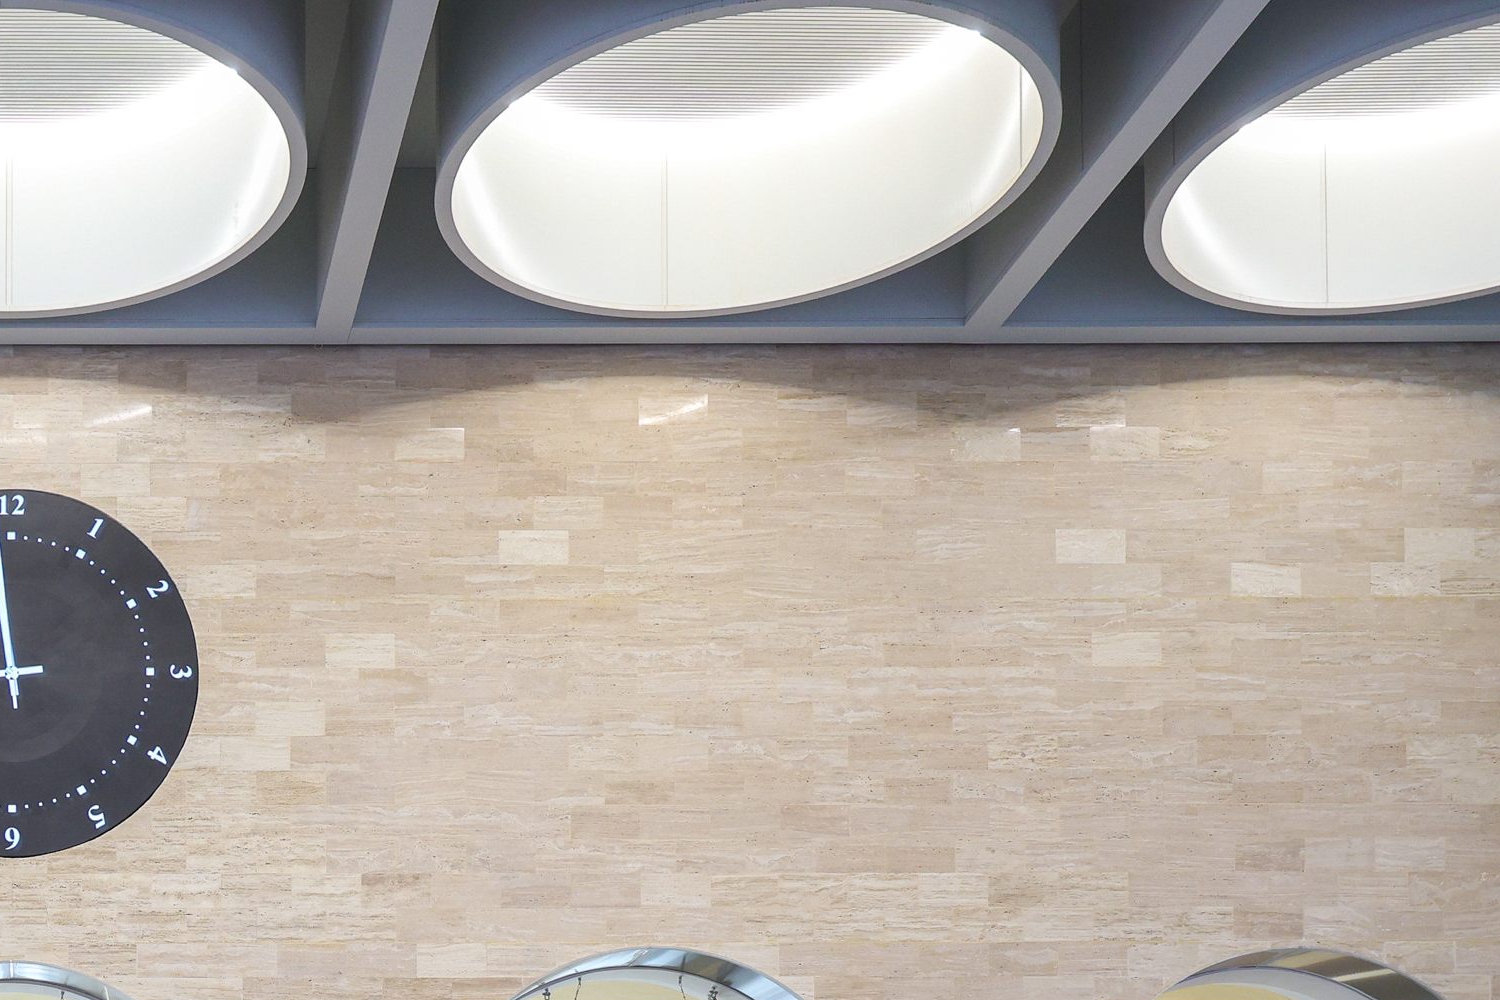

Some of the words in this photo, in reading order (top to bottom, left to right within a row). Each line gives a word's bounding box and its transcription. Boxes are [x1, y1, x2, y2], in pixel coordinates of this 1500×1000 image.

[86, 518, 104, 539] 1
[146, 580, 169, 599] 2
[169, 664, 193, 680] 3
[147, 746, 167, 765] 4
[88, 804, 106, 829] 5
[4, 827, 20, 850] 6
